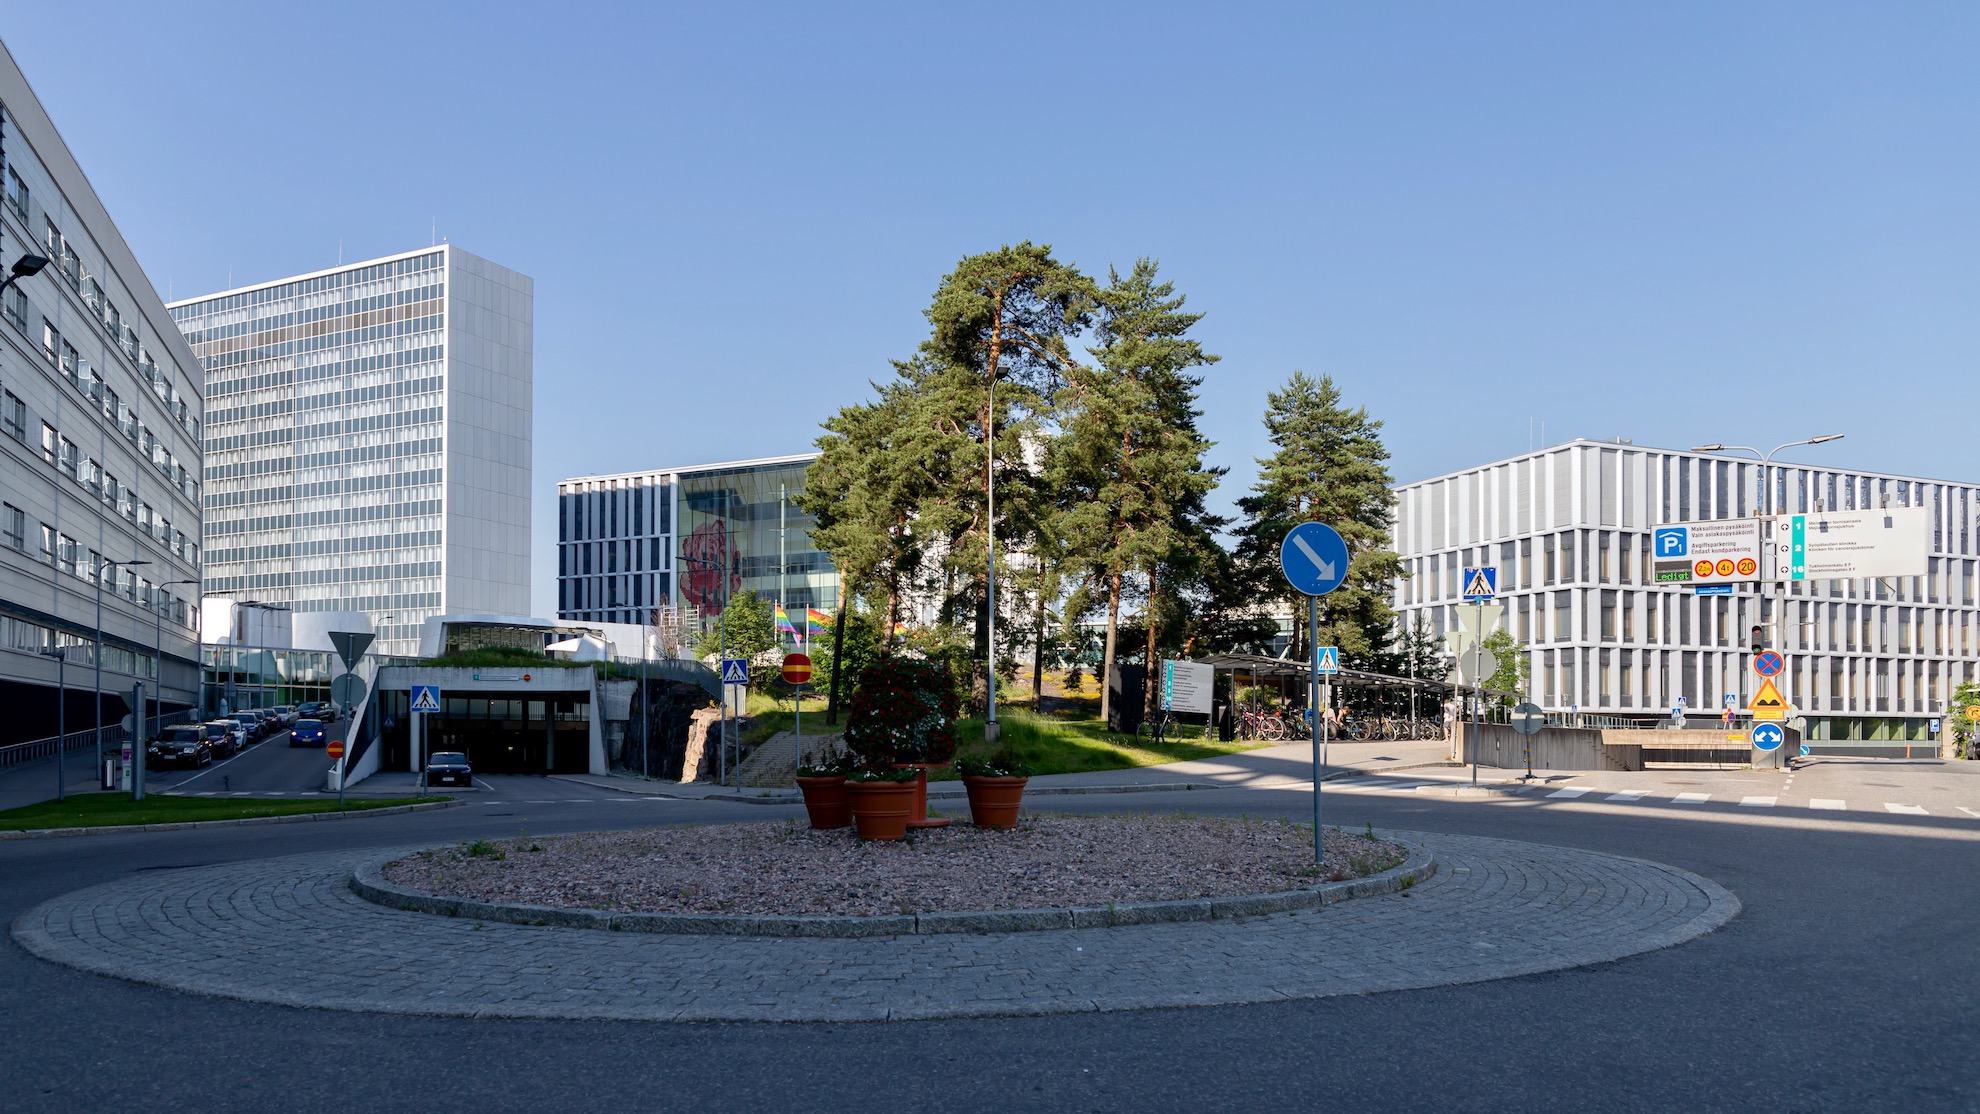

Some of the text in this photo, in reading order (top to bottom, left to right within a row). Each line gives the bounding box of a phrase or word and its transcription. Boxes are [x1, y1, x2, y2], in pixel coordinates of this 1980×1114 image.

[1725, 523, 1754, 531] pysäköinti
[1741, 562, 1753, 571] 20
[1655, 572, 1689, 581] Ledigt
